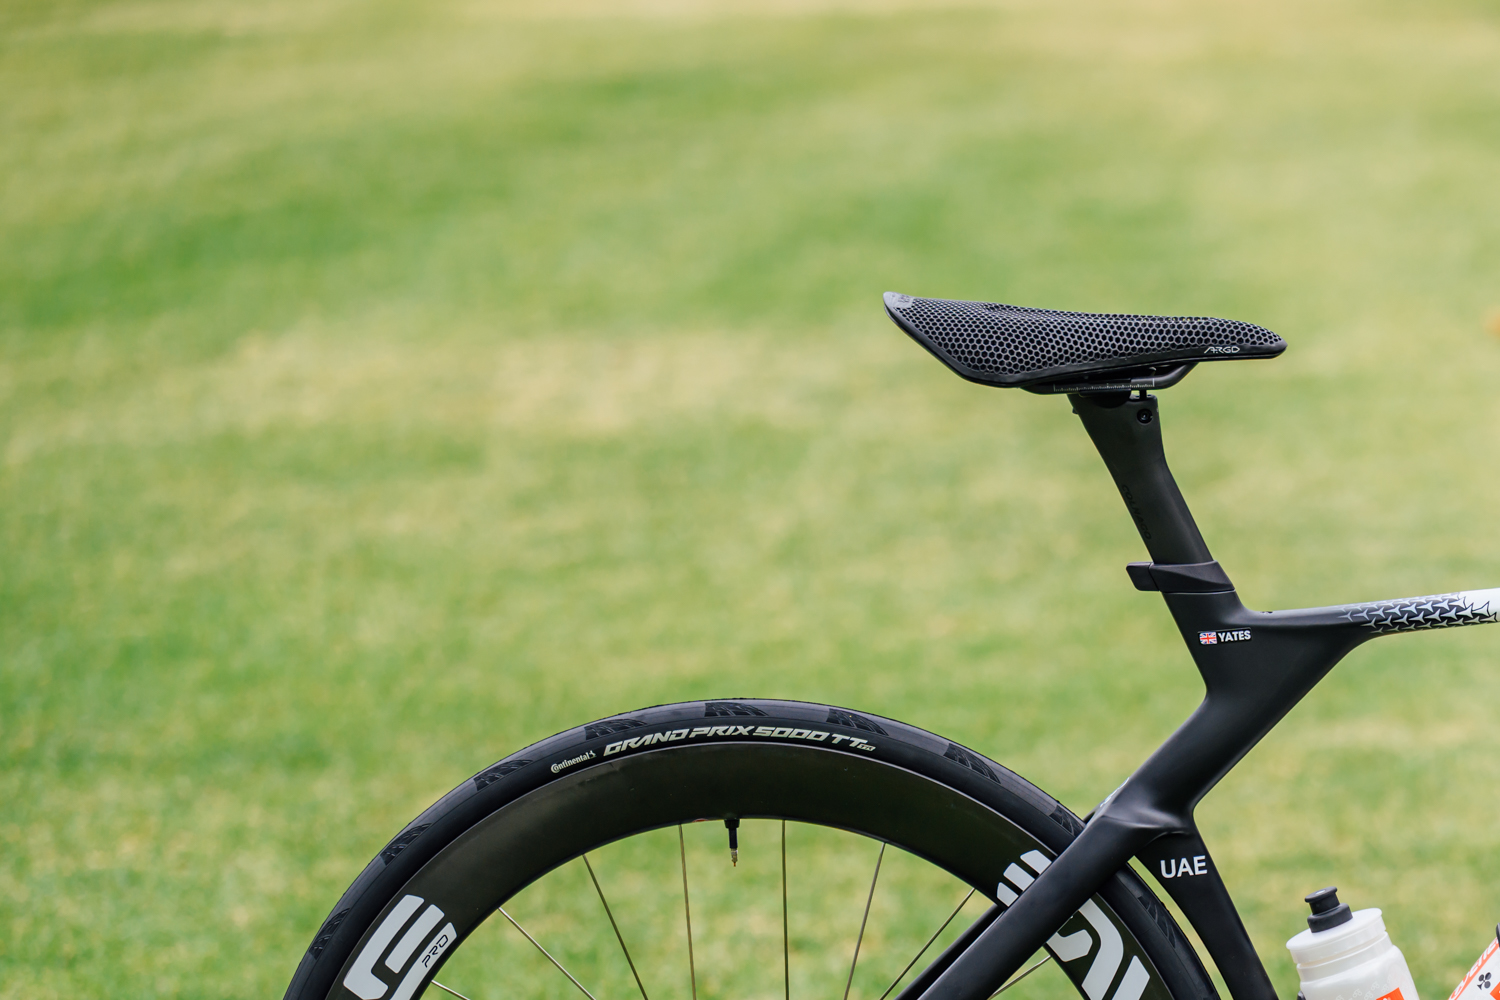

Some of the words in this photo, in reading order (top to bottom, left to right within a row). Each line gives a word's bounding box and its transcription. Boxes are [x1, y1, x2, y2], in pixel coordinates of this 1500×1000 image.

[1218, 630, 1251, 642] YATES
[550, 751, 591, 774] Continental
[603, 728, 689, 757] GRAND
[689, 725, 755, 738] PRIX
[752, 726, 831, 742] 5000
[831, 733, 868, 748] TT
[1160, 855, 1208, 878] UAE
[421, 934, 449, 968] PRO
